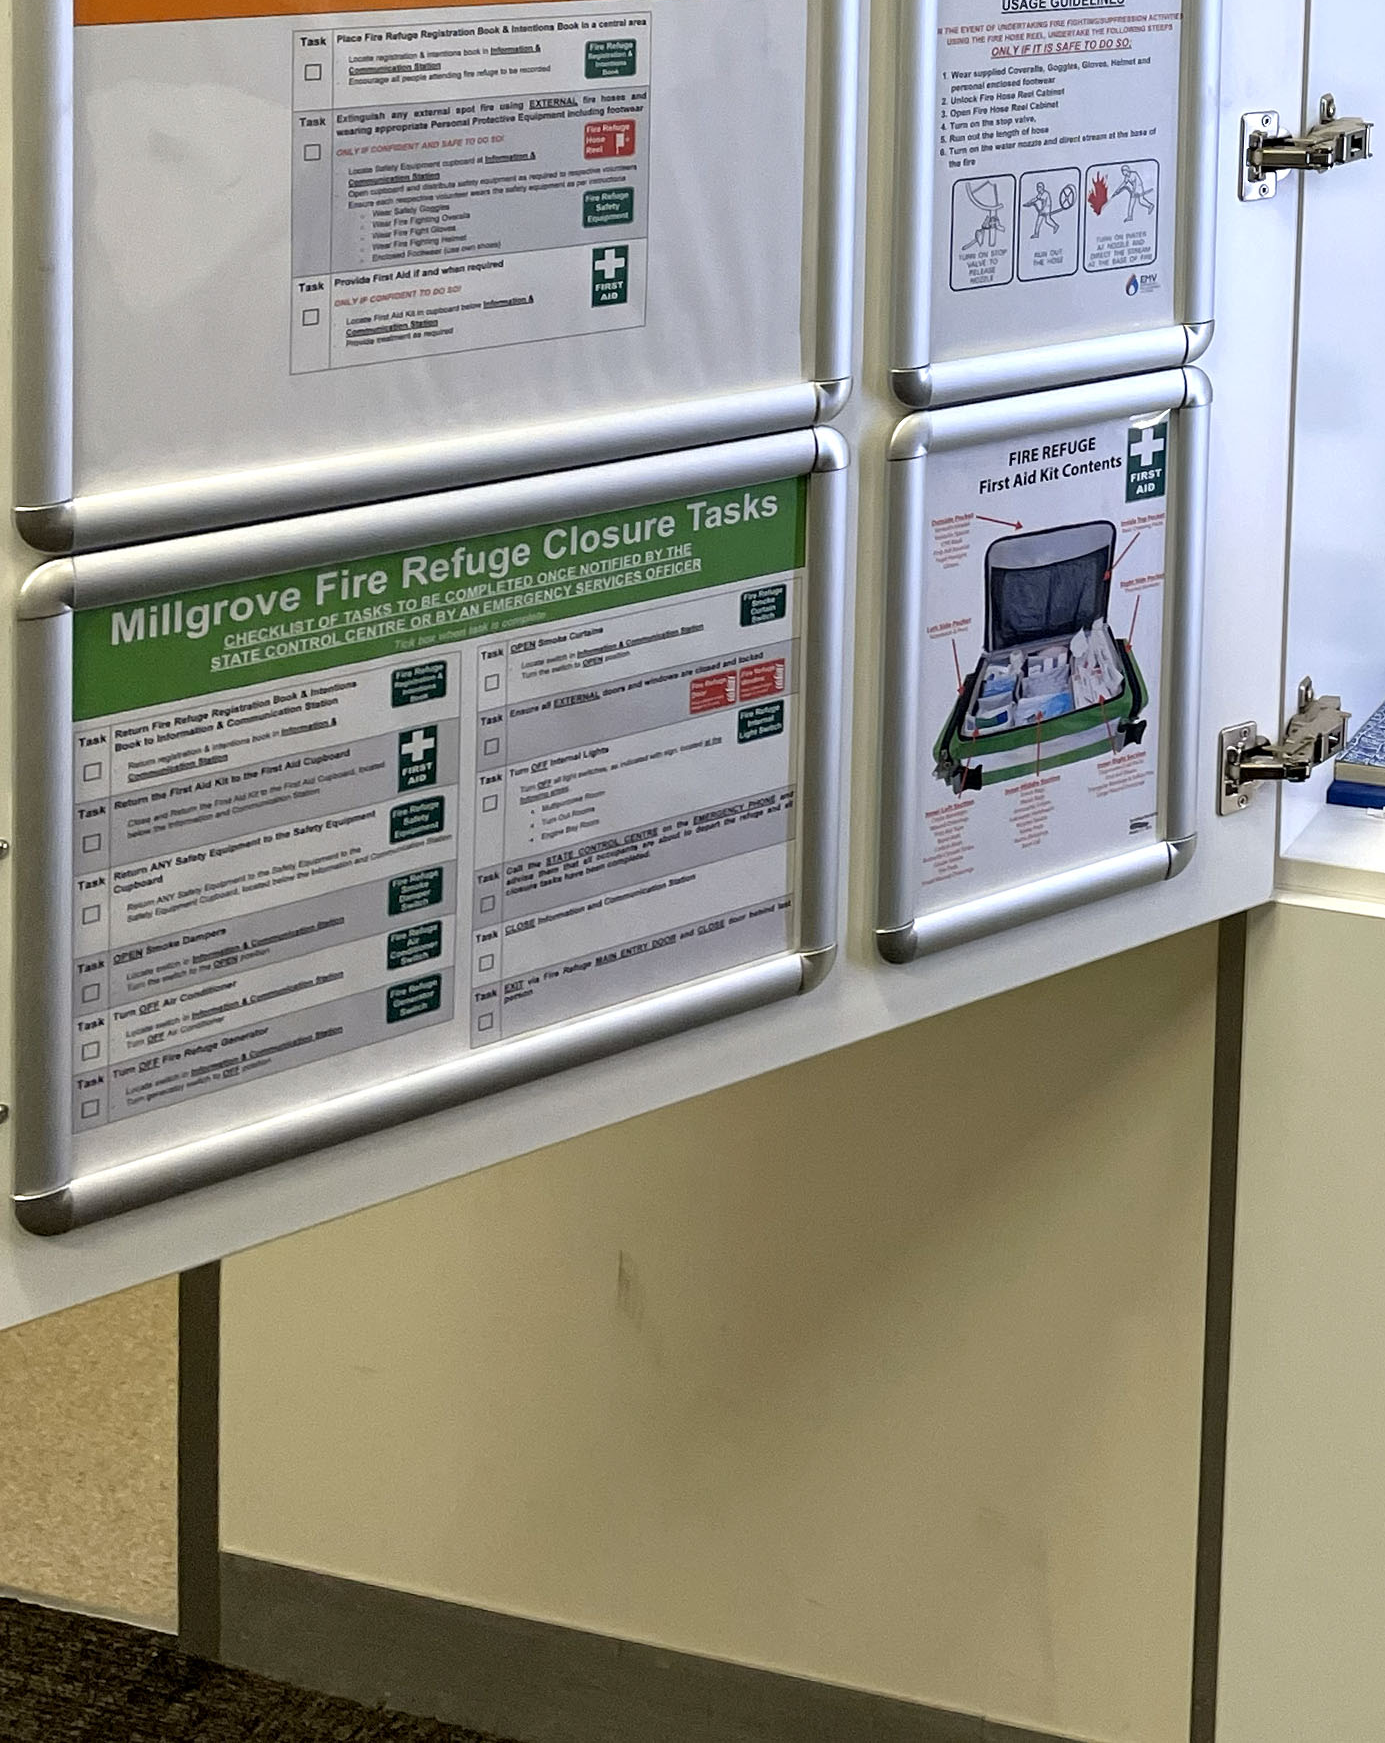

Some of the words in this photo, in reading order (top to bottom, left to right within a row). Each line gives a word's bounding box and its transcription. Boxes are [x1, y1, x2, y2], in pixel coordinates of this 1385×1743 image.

[1008, 447, 1038, 466] FIRE
[1042, 436, 1095, 460] REFUGE
[979, 476, 1009, 494] First
[1012, 469, 1036, 488] Aid
[1039, 466, 1058, 482] Kit
[1062, 456, 1121, 477] Contents
[1130, 468, 1161, 484] FIRST
[1135, 482, 1155, 494] AID
[111, 587, 300, 645] Millgrove
[316, 569, 387, 605] Fire
[402, 543, 530, 589] Refuge
[544, 513, 675, 559] Closure
[688, 493, 778, 531] Tasks
